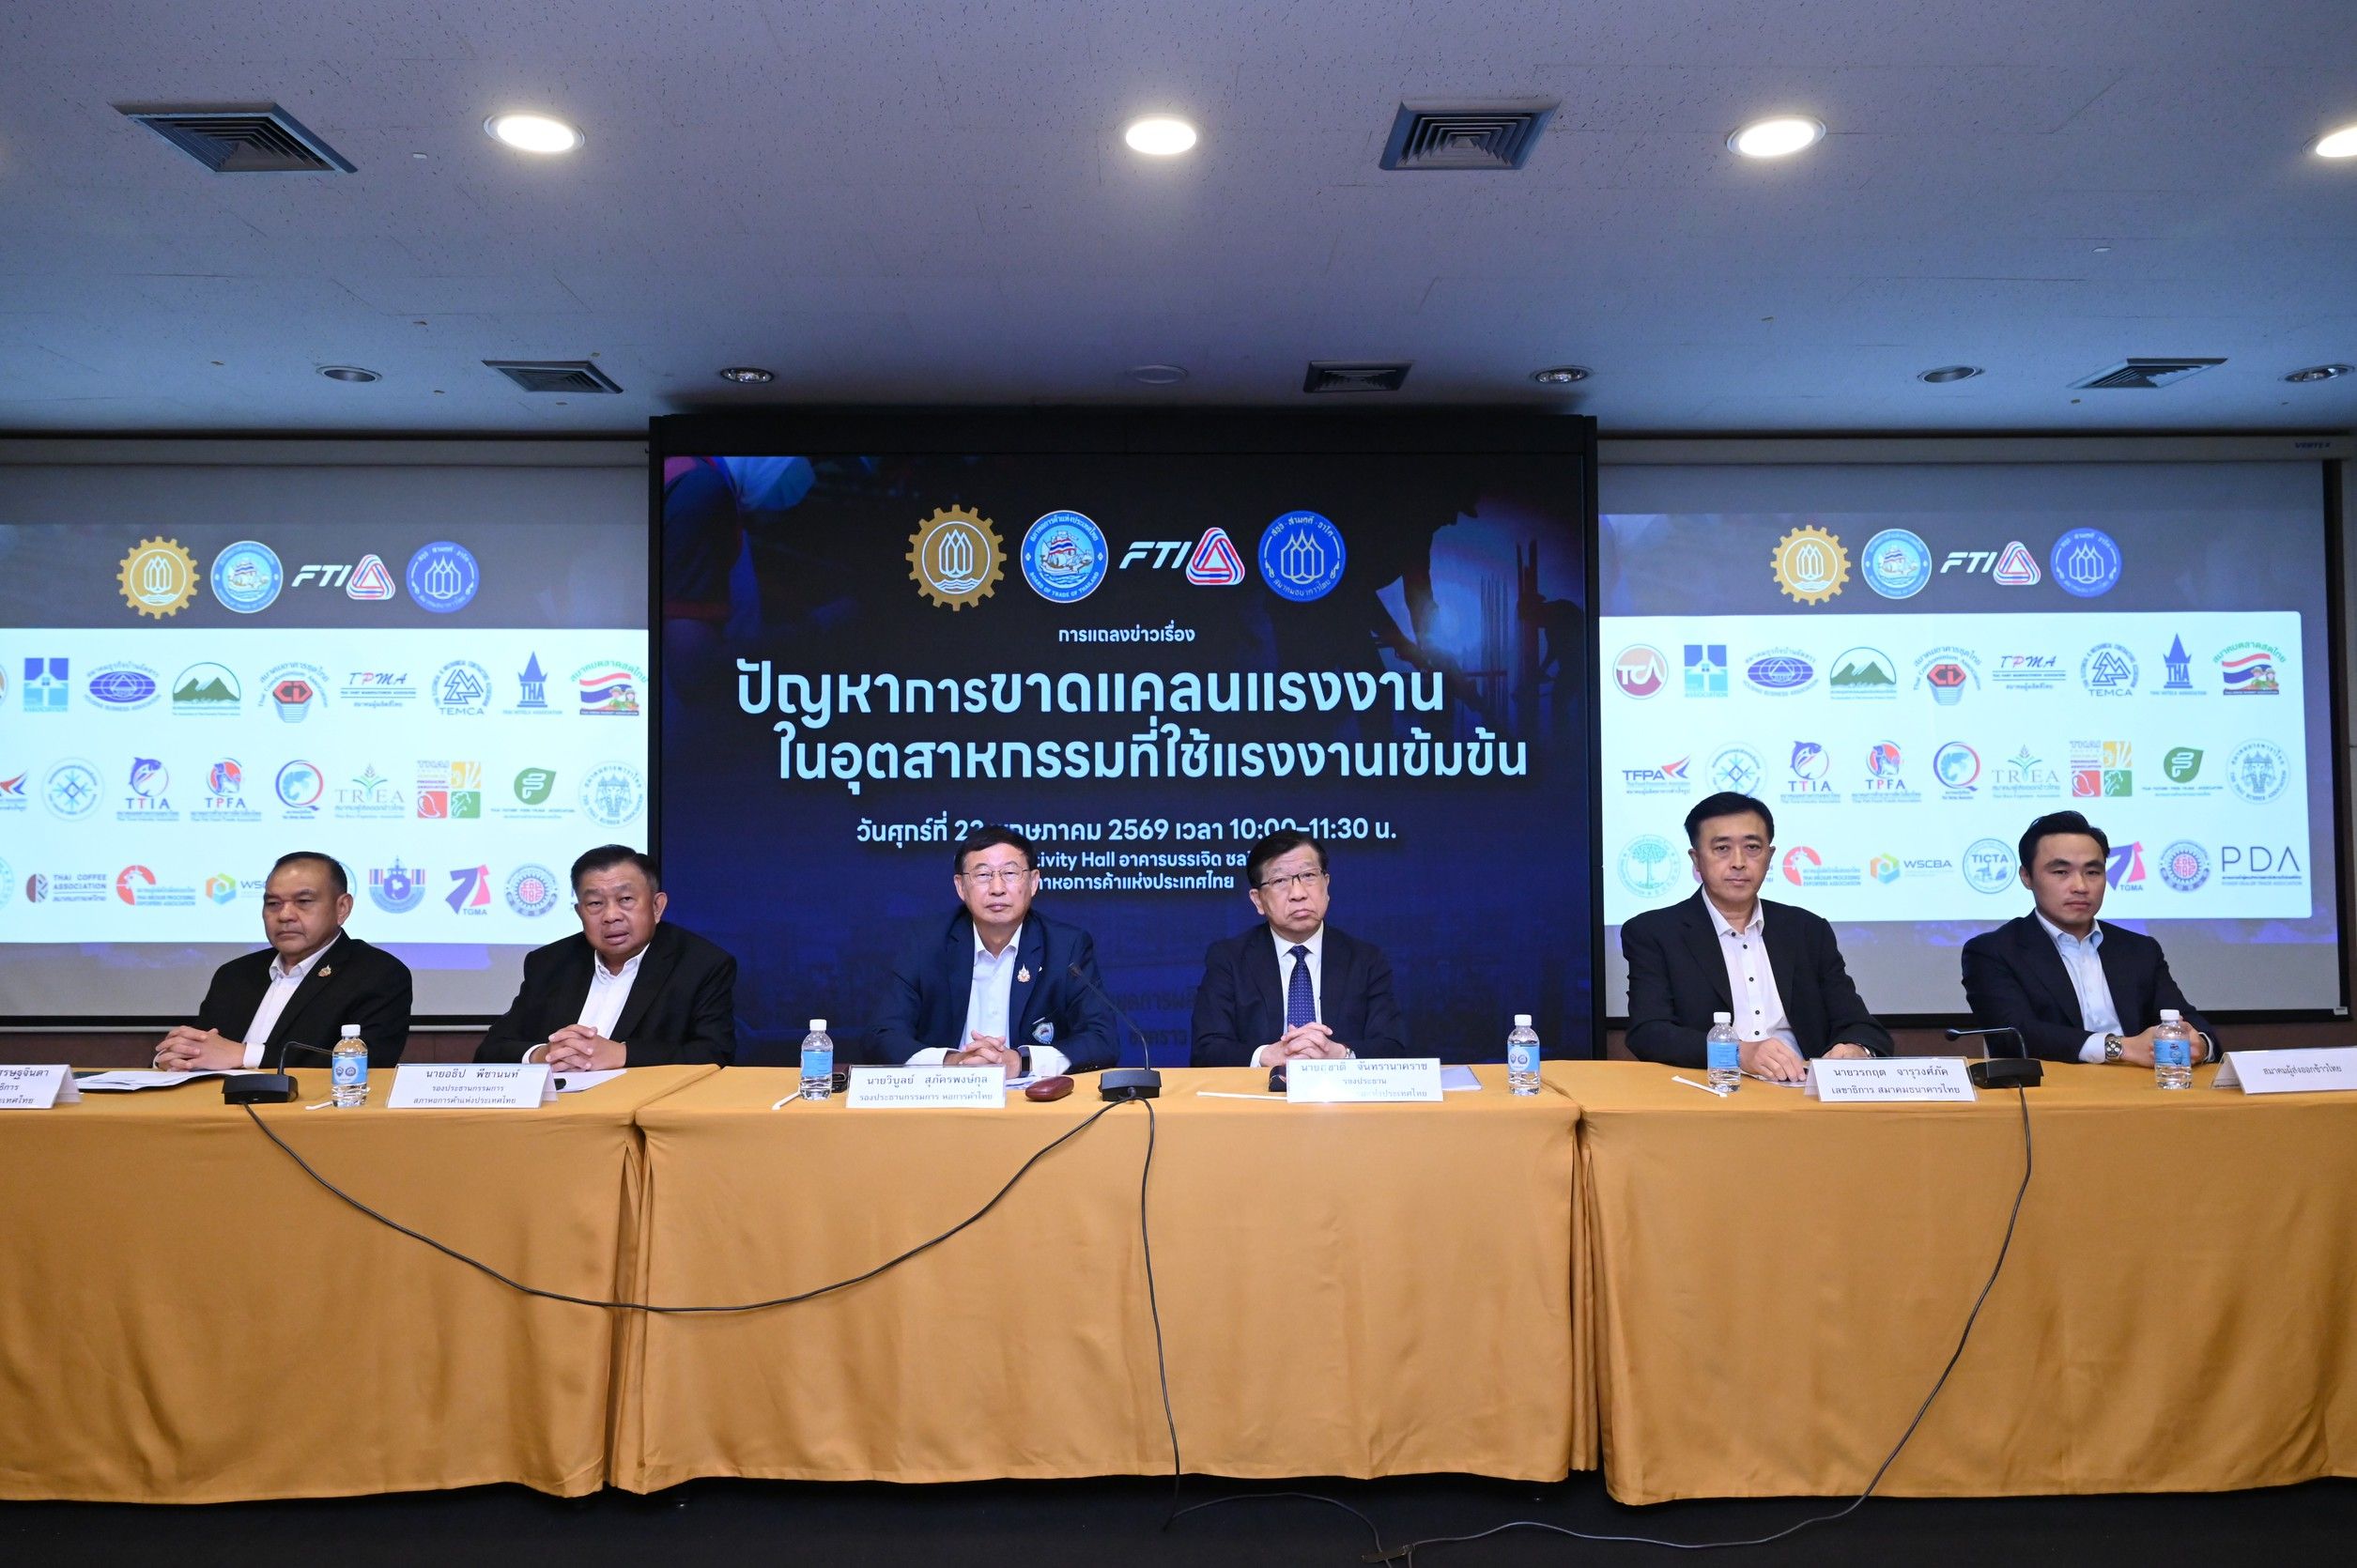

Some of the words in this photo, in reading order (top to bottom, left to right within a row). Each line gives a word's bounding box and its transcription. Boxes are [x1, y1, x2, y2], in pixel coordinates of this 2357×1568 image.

[1119, 542, 1193, 569] FTI
[1940, 552, 1997, 574] FTI
[291, 564, 352, 587] FTI
[1059, 620, 1195, 642] การแถลงข่าวเรื่อง
[2001, 656, 2056, 668] TPMA
[350, 672, 407, 684] TPMA
[2166, 664, 2189, 682] THA
[520, 683, 545, 700] THA
[737, 658, 1443, 729] ปัญหาการขาดแคลนแรงงาน
[2088, 688, 2133, 697] TEMCA
[439, 707, 484, 715] TEMCA
[774, 717, 1526, 794] ในอุตสาหกรรมที่ใช้แรงงานเข้มข้น
[1623, 770, 1665, 780] TFPA
[1788, 781, 1832, 792] TTIA
[1866, 779, 1905, 790] TPFA
[126, 798, 170, 809] TTIA
[206, 798, 246, 808] TPFA
[857, 811, 947, 848] วันศุกร์ที่
[1109, 819, 1168, 840] 2569
[1177, 822, 1223, 840] เวลา
[1376, 822, 1396, 838] น.
[1082, 852, 1115, 867] Hall
[1119, 851, 1222, 866] อาคารบรรเจิด
[1225, 851, 1253, 866] ชล
[1904, 860, 1952, 869] WSCBA
[1972, 854, 2009, 863] TICTA
[2222, 846, 2301, 872] PDA
[1357, 1061, 1427, 1070] จันทรานาคราช
[2262, 1063, 2343, 1077] สมาคมผู้ส่งออกข้าวไทย
[1897, 1066, 1949, 1079] จารุวงศ์ภัค
[867, 1075, 915, 1088] นายวิบูลย์
[925, 1073, 988, 1087] สุภัครพงษ์กุล
[1830, 1084, 1874, 1094] เลขาธิการ
[1878, 1083, 1961, 1094] สมาคมธนาคารไทย
[413, 1095, 516, 1104] สภาหอการค้าแห่งประเทศไทย
[859, 1093, 939, 1101] รองประธานกรรมการ
[942, 1091, 993, 1100] หอการค้าไทย
